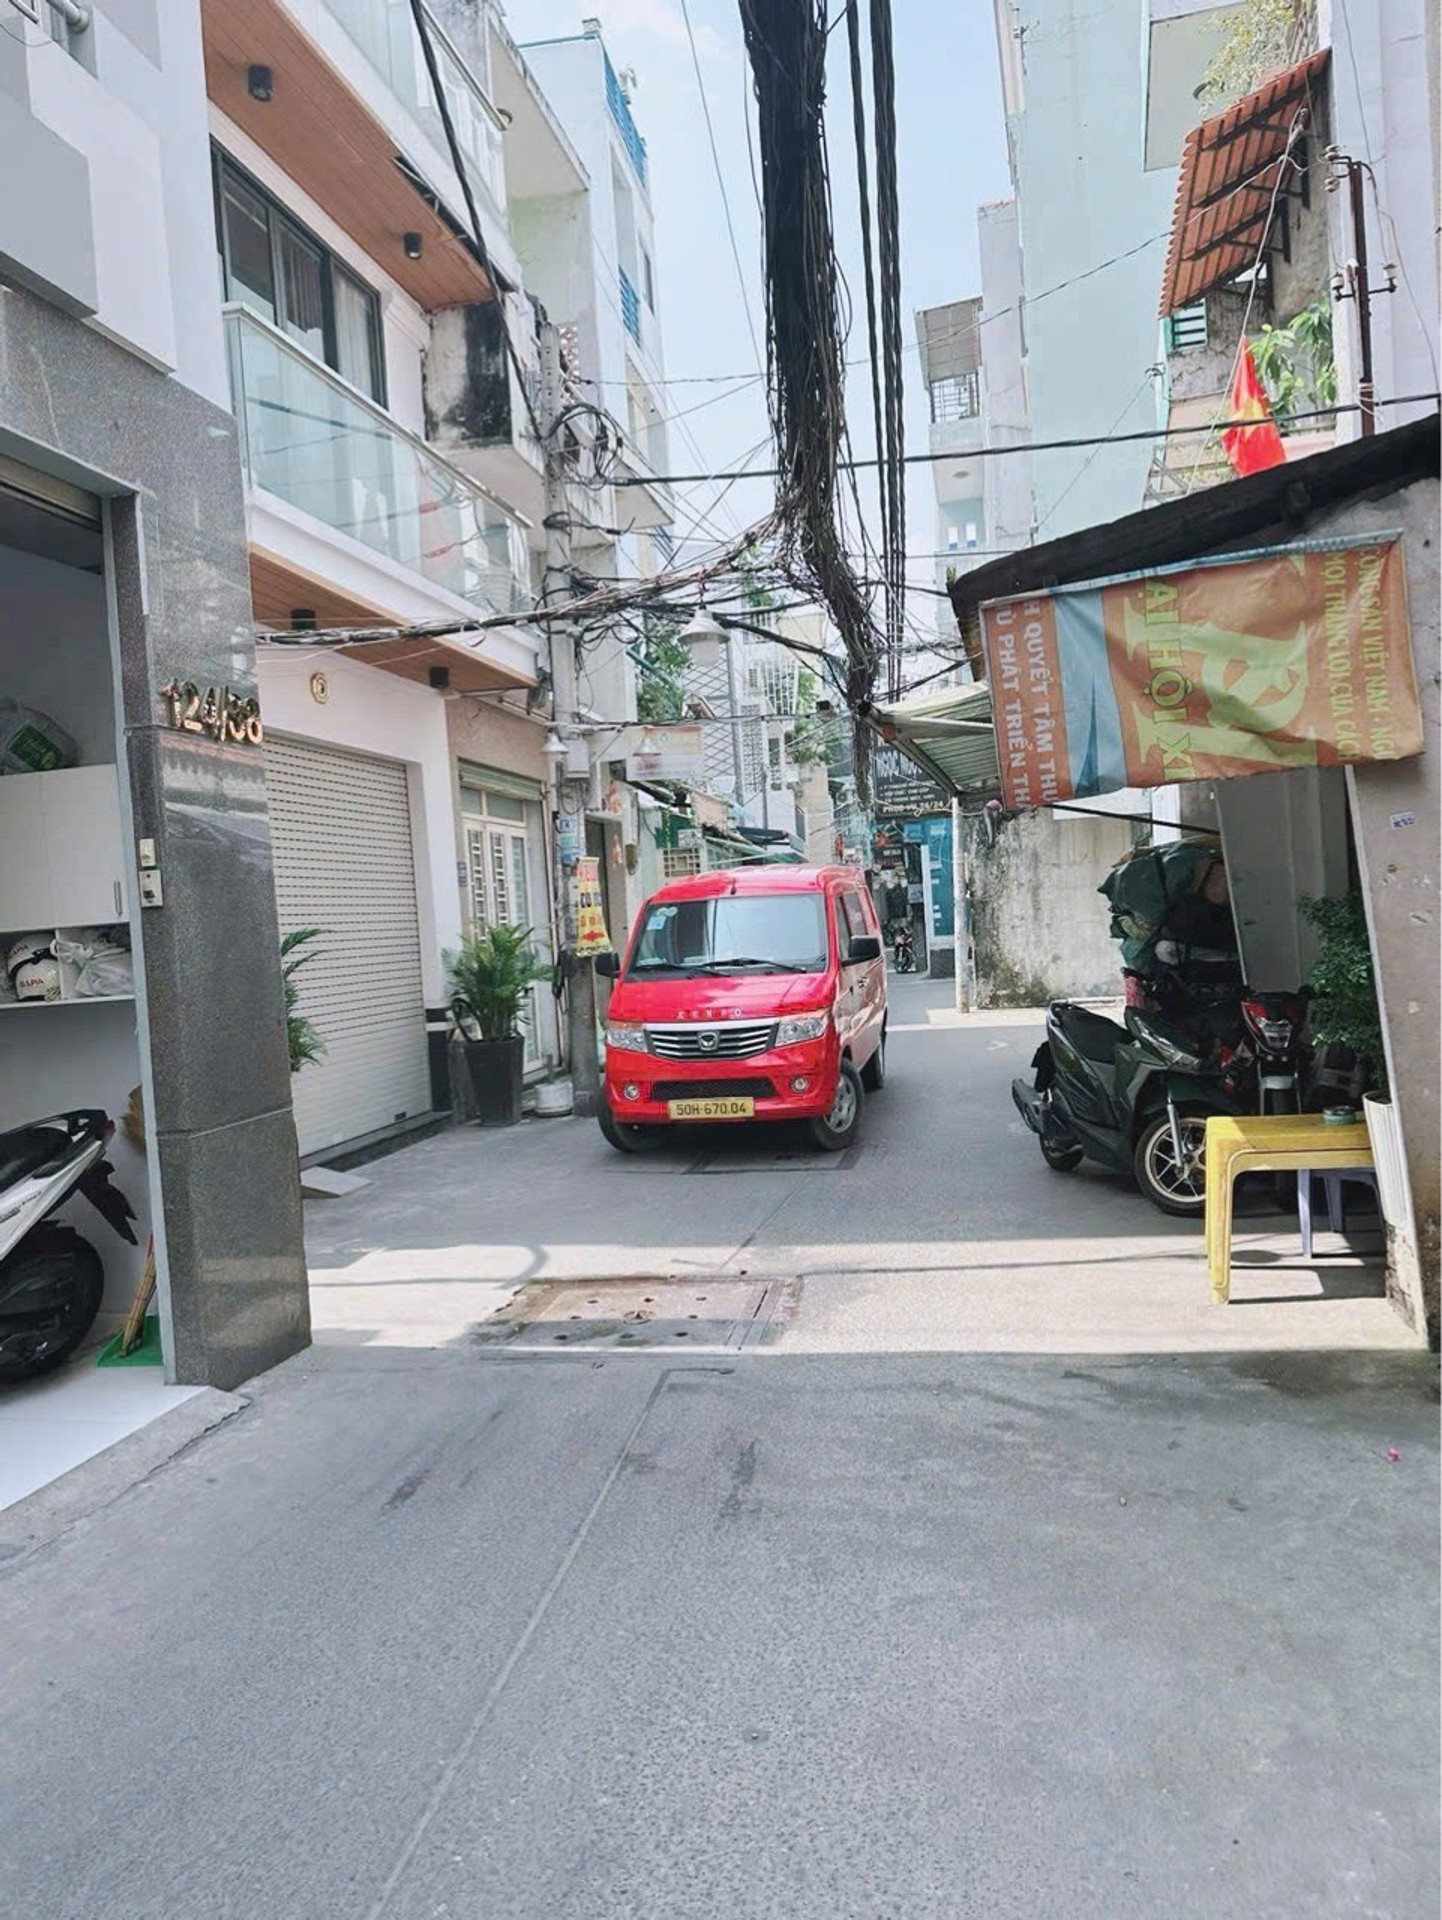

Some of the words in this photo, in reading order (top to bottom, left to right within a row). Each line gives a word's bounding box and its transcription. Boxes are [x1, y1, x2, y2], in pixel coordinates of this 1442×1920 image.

[998, 633, 1022, 693] PHÁT
[1024, 622, 1054, 695] QUYẾT
[1359, 634, 1389, 670] VIỆT
[1144, 639, 1193, 724] HỘI
[1330, 683, 1360, 717] CỦA
[1364, 674, 1391, 713] NAM
[1005, 699, 1034, 768] TRIỂN
[1033, 702, 1056, 753] TÂM
